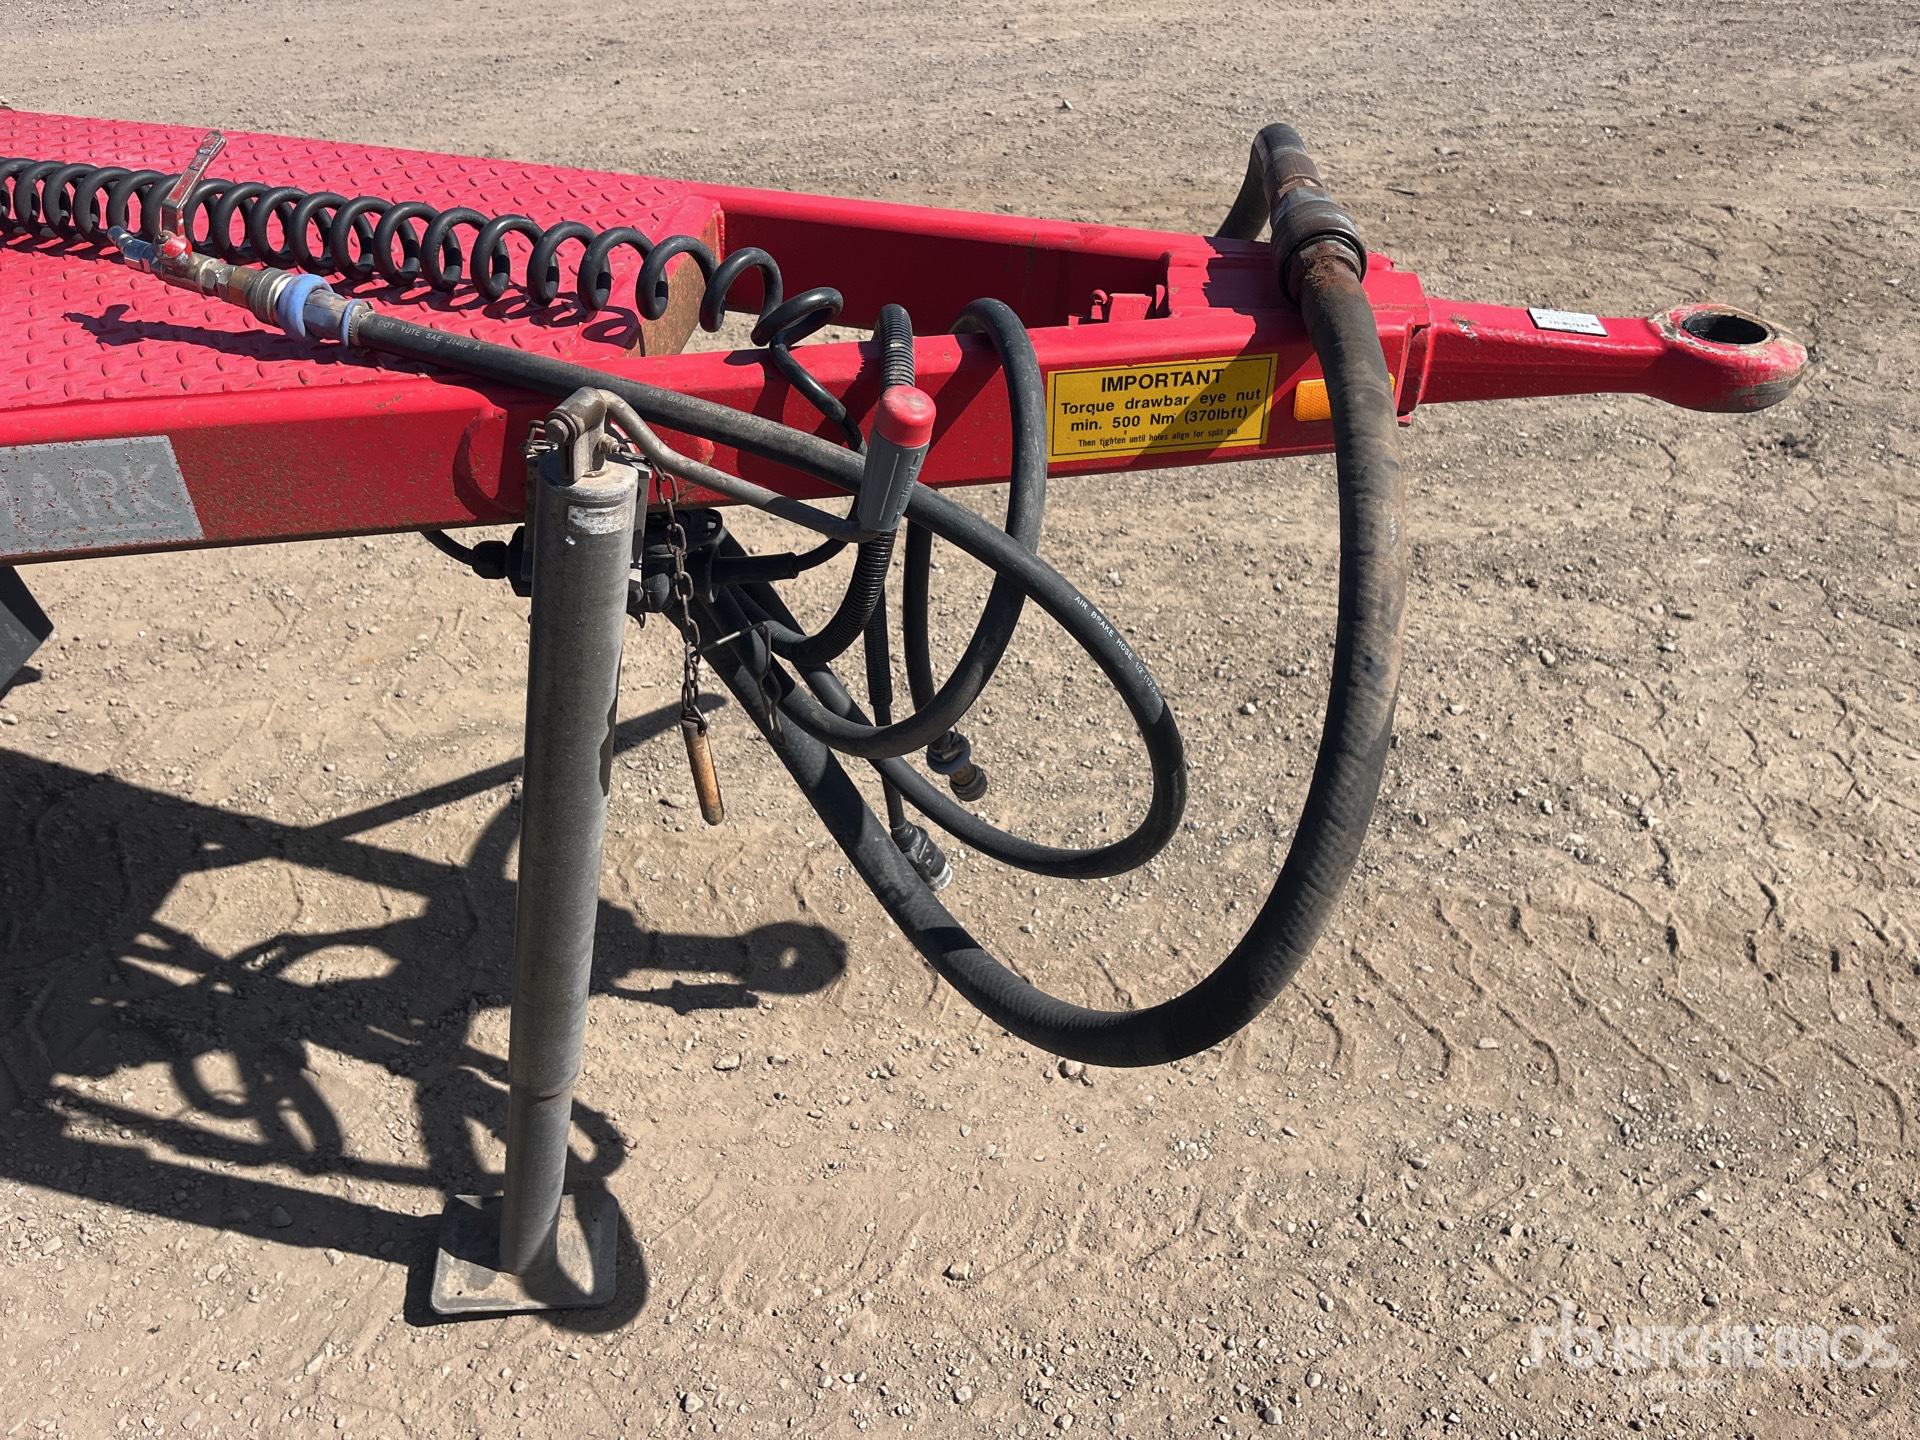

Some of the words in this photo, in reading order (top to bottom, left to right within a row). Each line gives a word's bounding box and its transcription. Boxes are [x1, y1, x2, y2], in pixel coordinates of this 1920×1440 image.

[378, 319, 394, 329] DOT
[400, 324, 421, 337] YUTE
[425, 331, 442, 342] SAE
[473, 343, 481, 352] A
[1101, 368, 1225, 392] IMPORTANT
[647, 389, 663, 399] AIR
[667, 394, 697, 410] BRAKE
[1061, 400, 1115, 416] Torque
[1124, 395, 1190, 410] drawbar
[1199, 392, 1227, 407] eye
[1235, 388, 1261, 402] nut
[1070, 418, 1103, 432] min.
[1111, 415, 1141, 429] 500
[1149, 413, 1175, 426] Nm
[1184, 405, 1248, 426] (370lbft)
[1078, 438, 1096, 447] Then
[1099, 436, 1126, 449] tighten
[1129, 434, 1146, 443] until
[1149, 432, 1168, 442] holes
[1171, 431, 1190, 442] align
[1193, 429, 1204, 438] for
[1207, 428, 1224, 439] split
[1226, 427, 1238, 438] pin
[1074, 596, 1089, 611] AIR
[1090, 610, 1115, 638] BRAKE
[1116, 638, 1133, 661] HOSE
